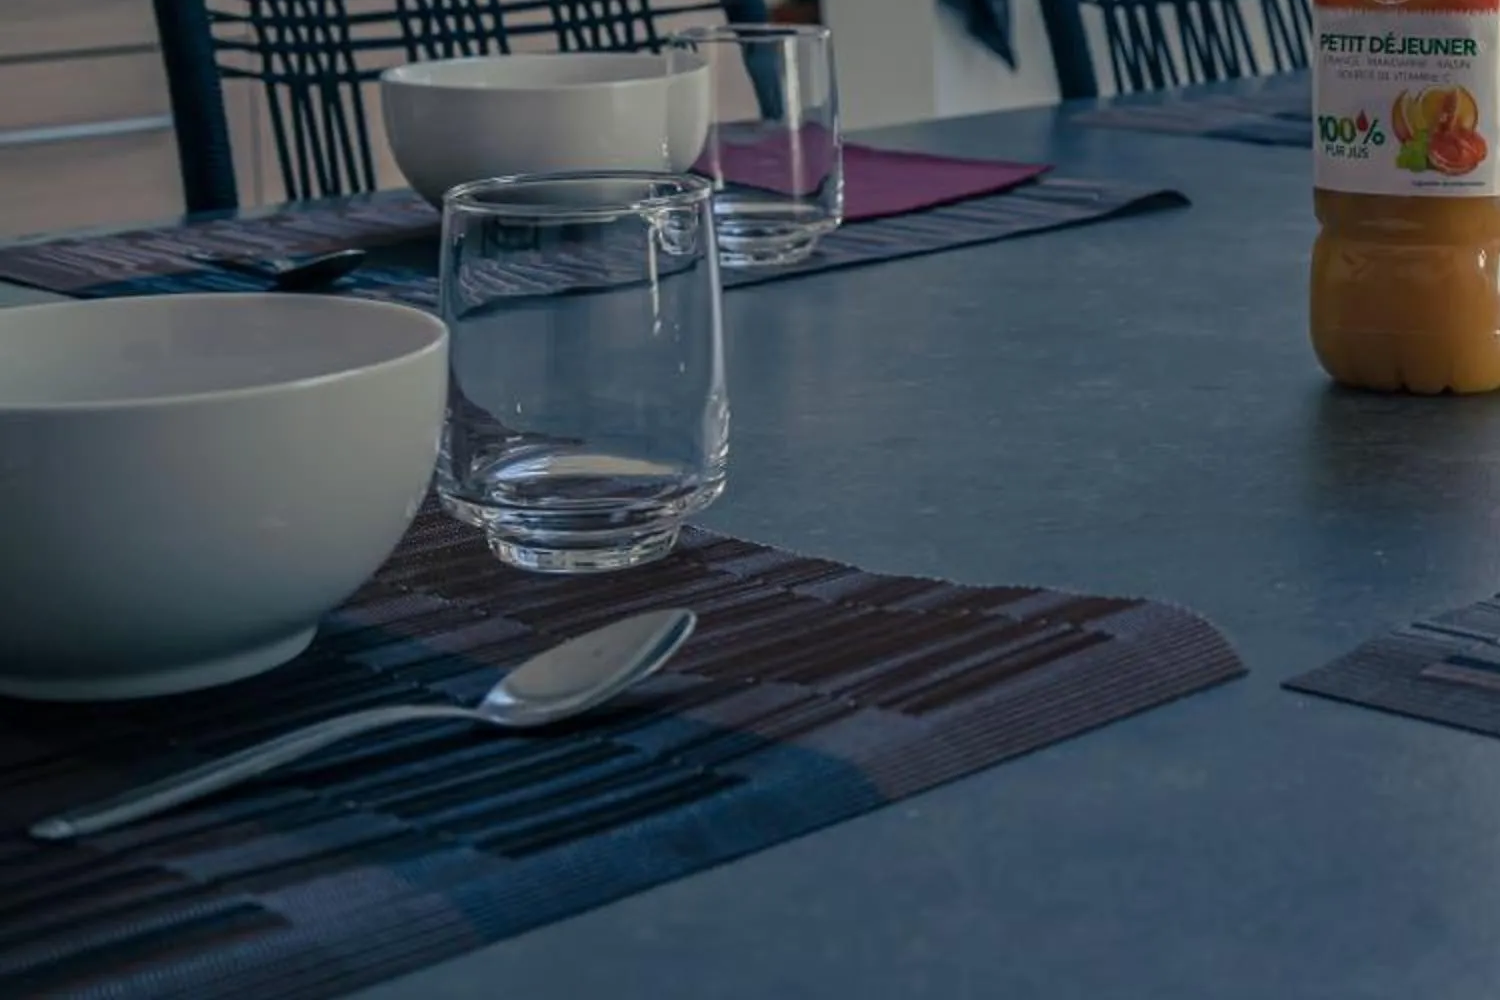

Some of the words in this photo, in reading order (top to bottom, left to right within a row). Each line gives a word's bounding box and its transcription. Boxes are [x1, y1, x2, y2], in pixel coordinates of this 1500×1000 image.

[1320, 34, 1366, 53] PETIT
[1369, 31, 1477, 56] DÉJEUNER
[1318, 110, 1385, 146] 100%
[1325, 144, 1346, 157] PUR
[1347, 145, 1369, 159] JUS
